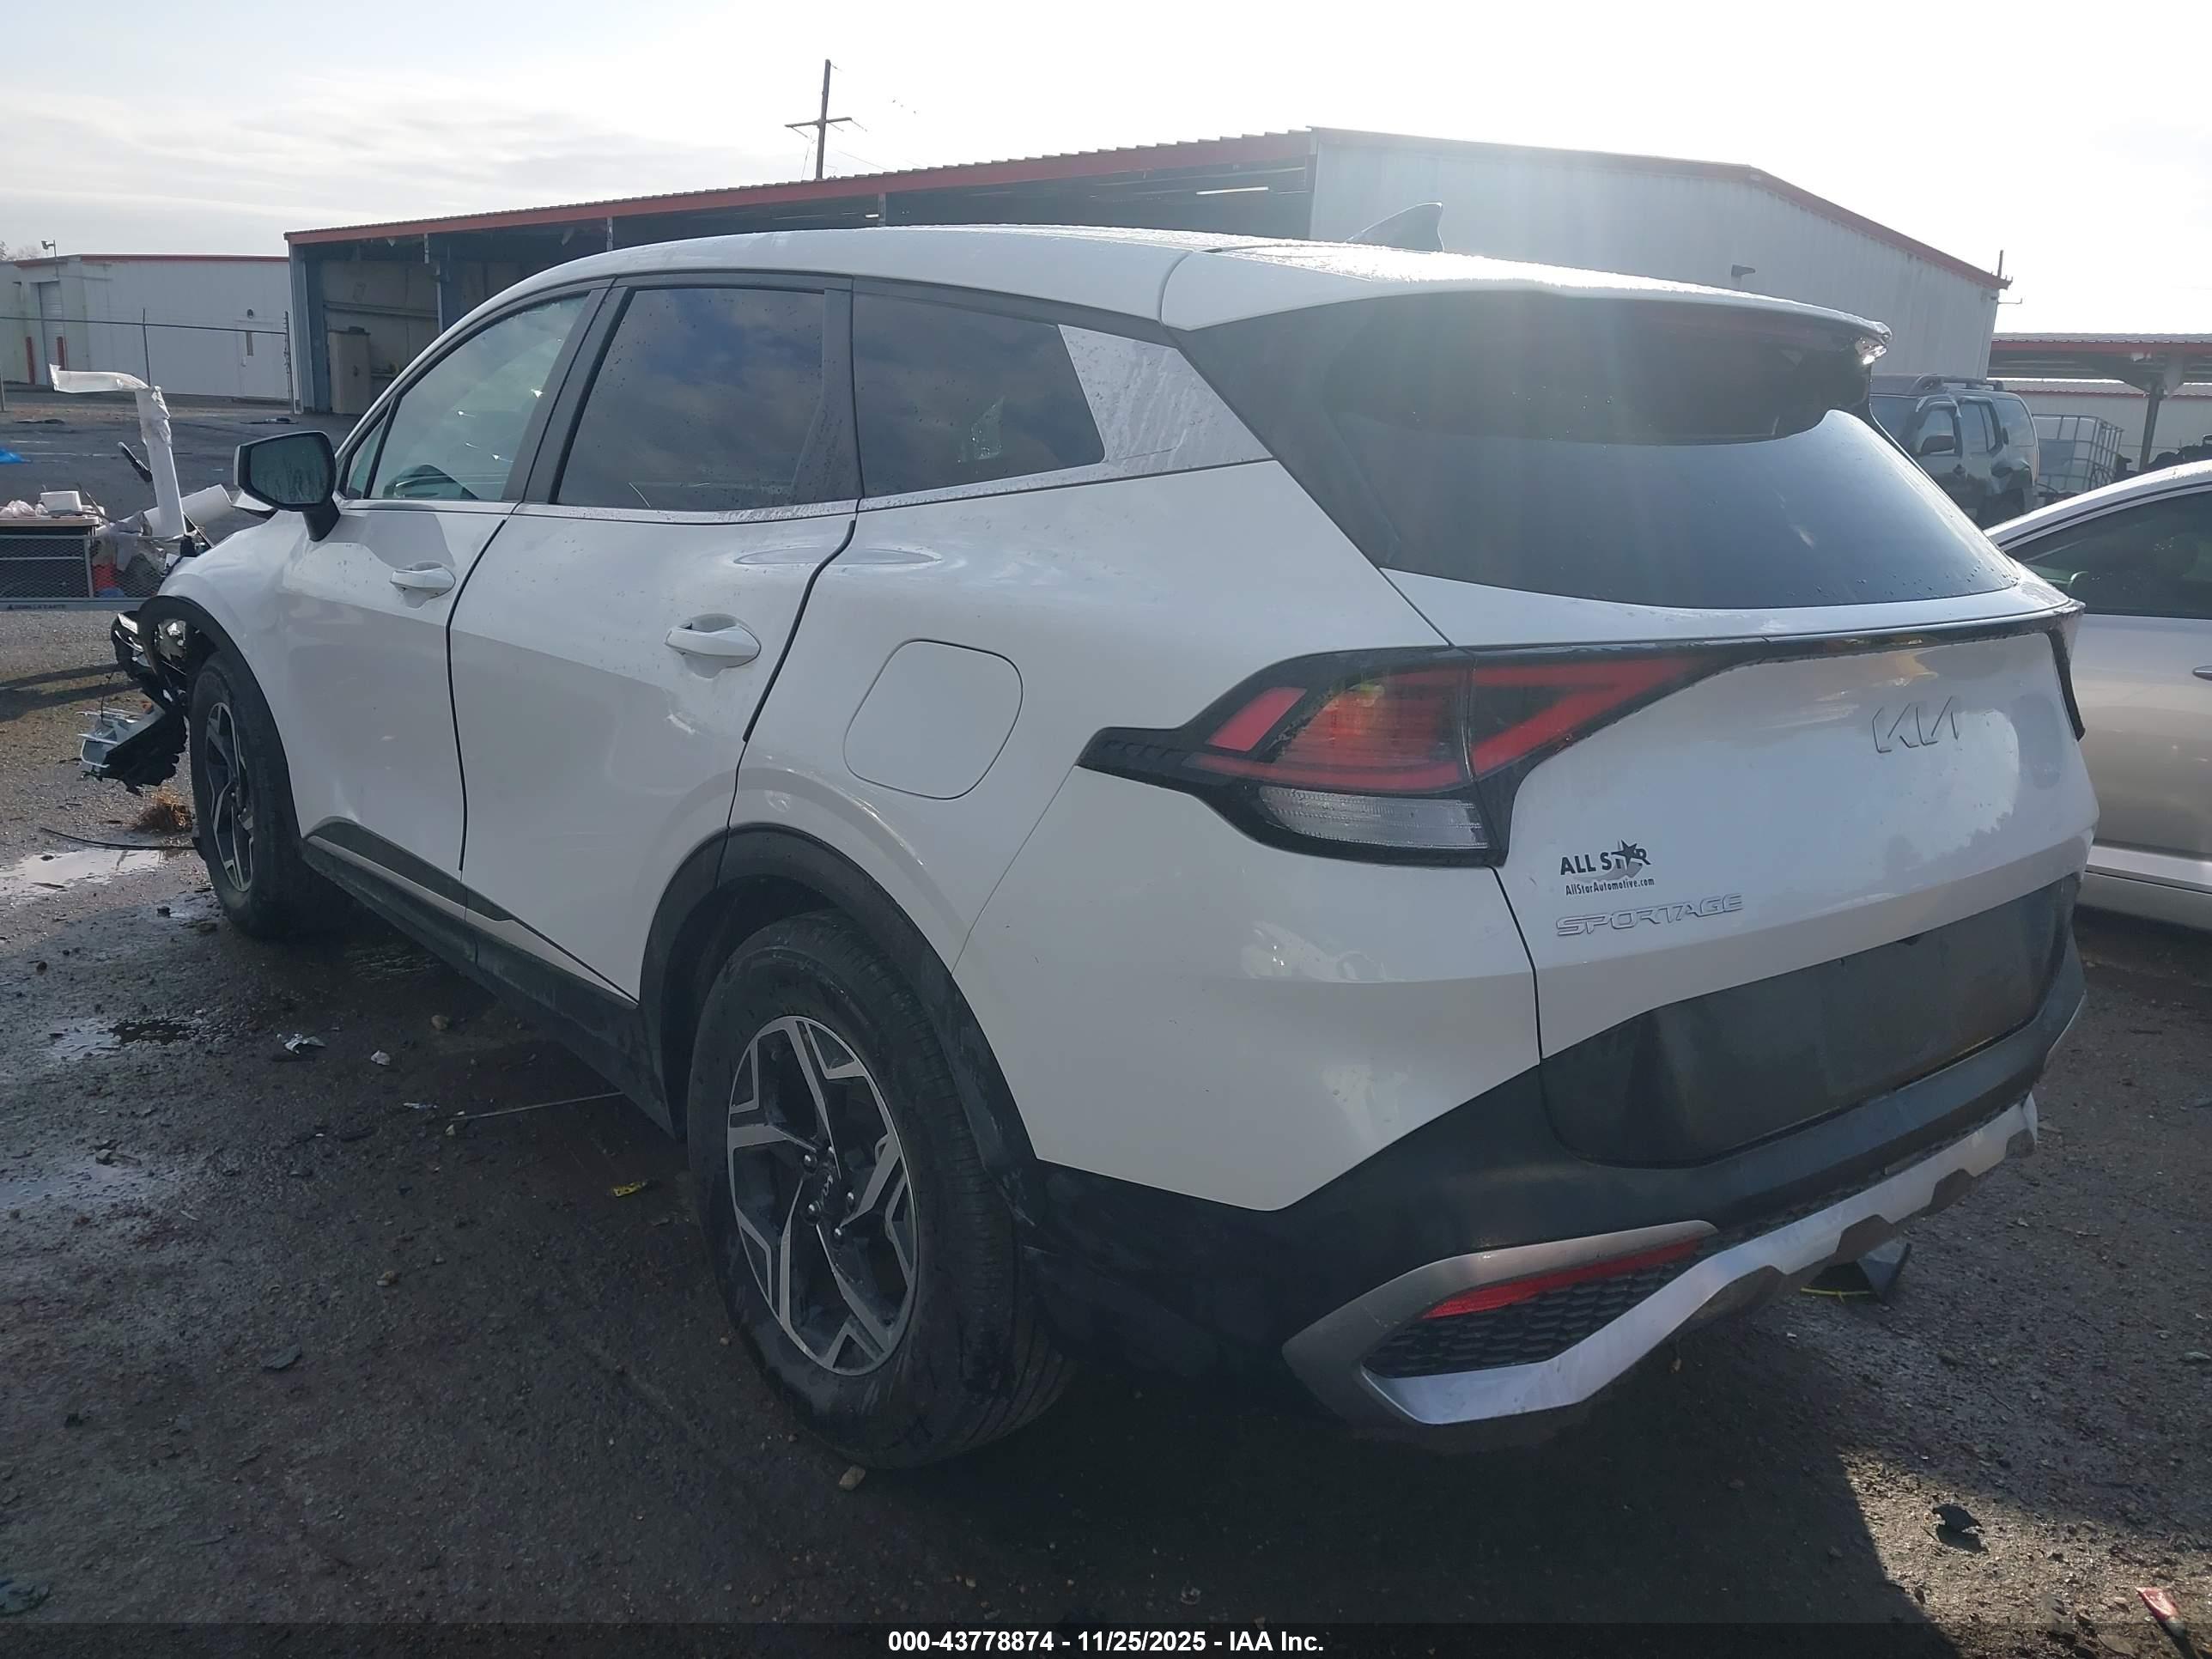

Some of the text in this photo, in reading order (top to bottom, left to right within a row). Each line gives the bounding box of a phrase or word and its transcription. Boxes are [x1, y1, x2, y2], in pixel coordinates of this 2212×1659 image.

[1560, 854, 1596, 876] ALL
[1565, 878, 1655, 896] AllStarAutomotive.com
[1556, 892, 1743, 936] SPORTAGE
